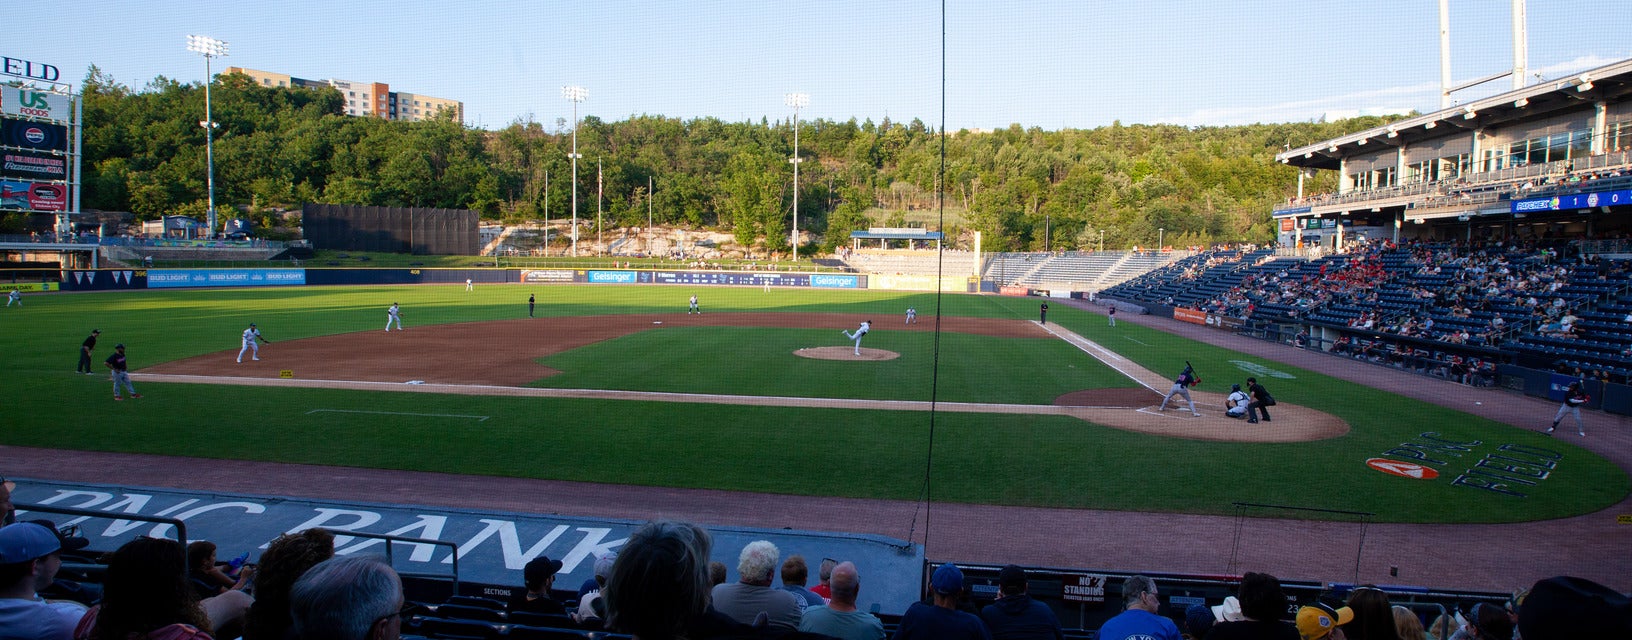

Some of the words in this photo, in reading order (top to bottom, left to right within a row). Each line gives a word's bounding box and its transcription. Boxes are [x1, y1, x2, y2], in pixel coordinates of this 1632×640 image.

[20, 107, 49, 117] FOODS
[1573, 197, 1578, 206] 1
[1612, 193, 1618, 203] 0
[593, 272, 631, 282] Geisinger
[815, 275, 853, 287] Geisinger
[1381, 431, 1483, 466] PNC
[1450, 443, 1563, 498] FIELD
[15, 489, 266, 542] PNC
[1078, 576, 1091, 586] NO
[483, 587, 512, 596] SECTIONS
[1063, 585, 1105, 596] STANDING
